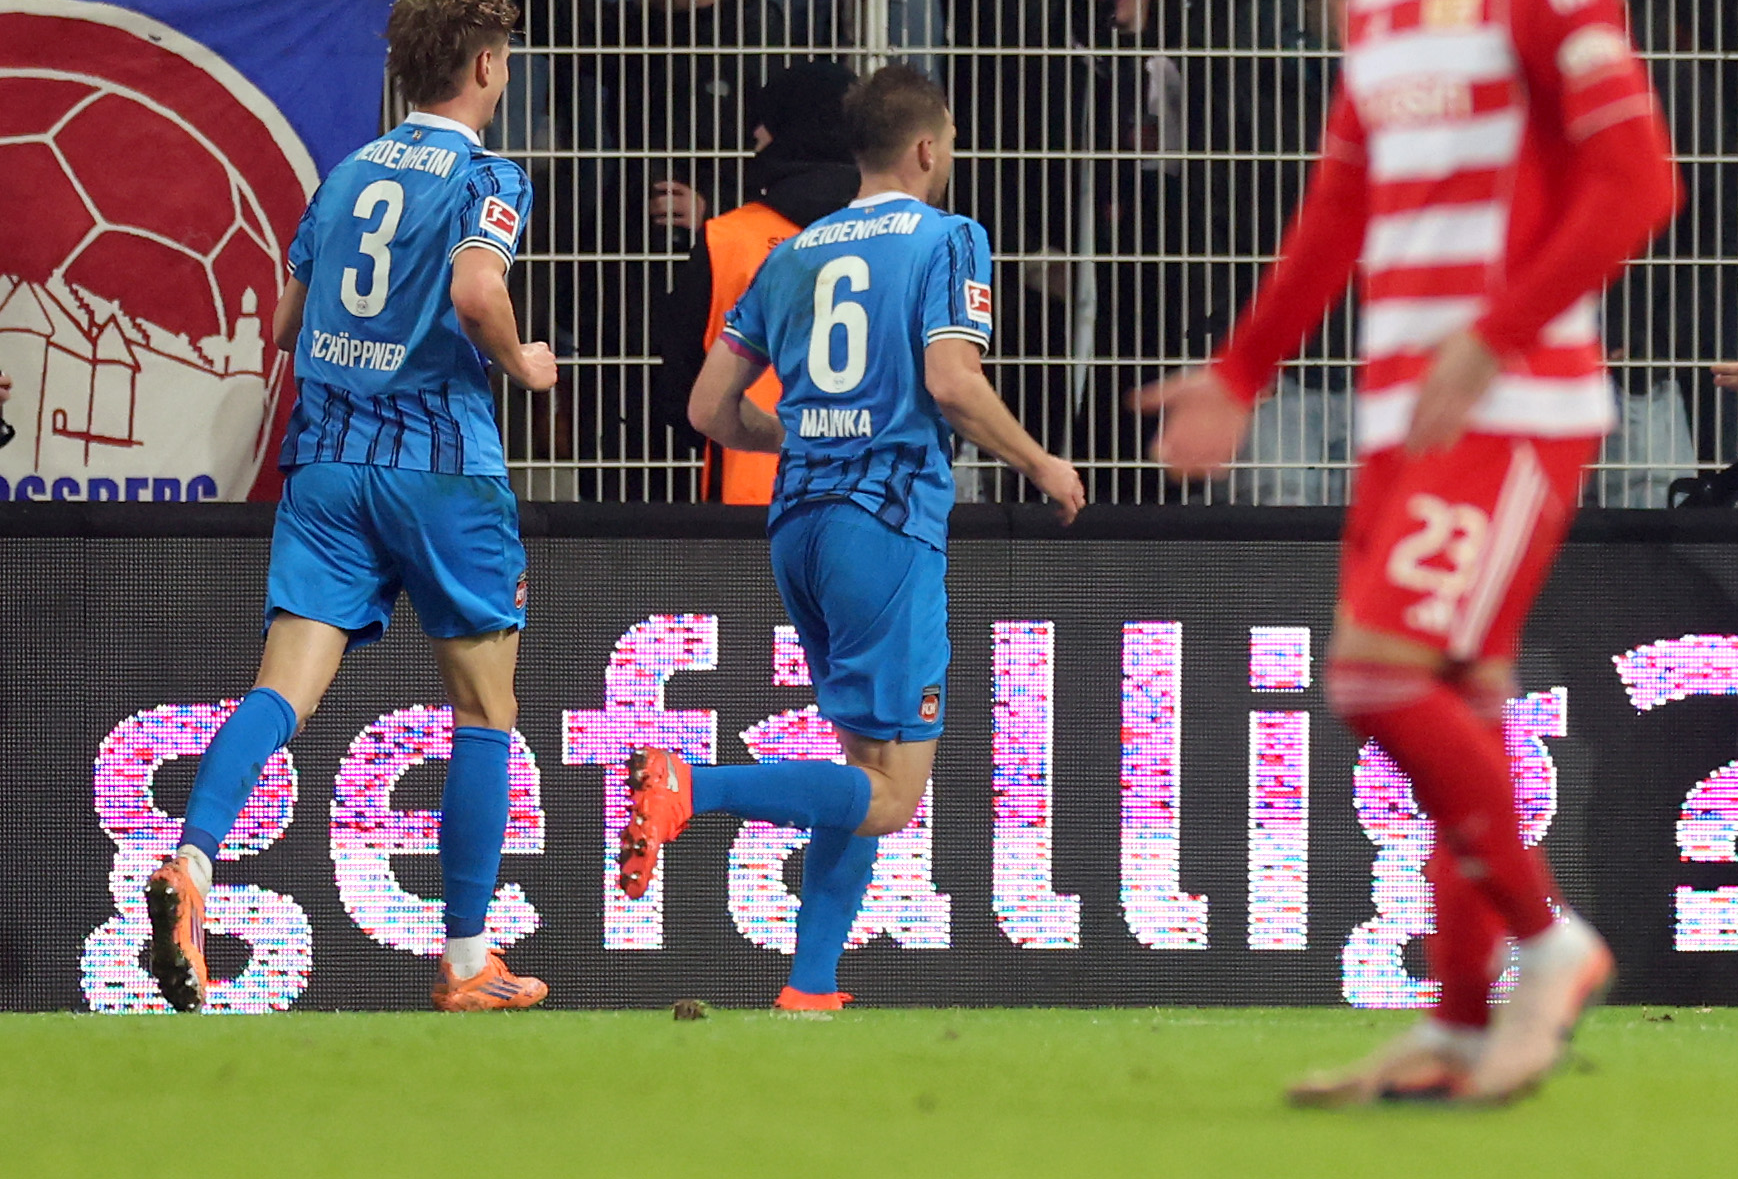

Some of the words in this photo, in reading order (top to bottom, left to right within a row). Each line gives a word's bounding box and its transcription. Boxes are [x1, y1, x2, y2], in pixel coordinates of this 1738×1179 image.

[341, 180, 405, 318] 3
[793, 212, 922, 251] HEIDENHEIM
[808, 255, 871, 394] 6
[1385, 492, 1490, 596] 23
